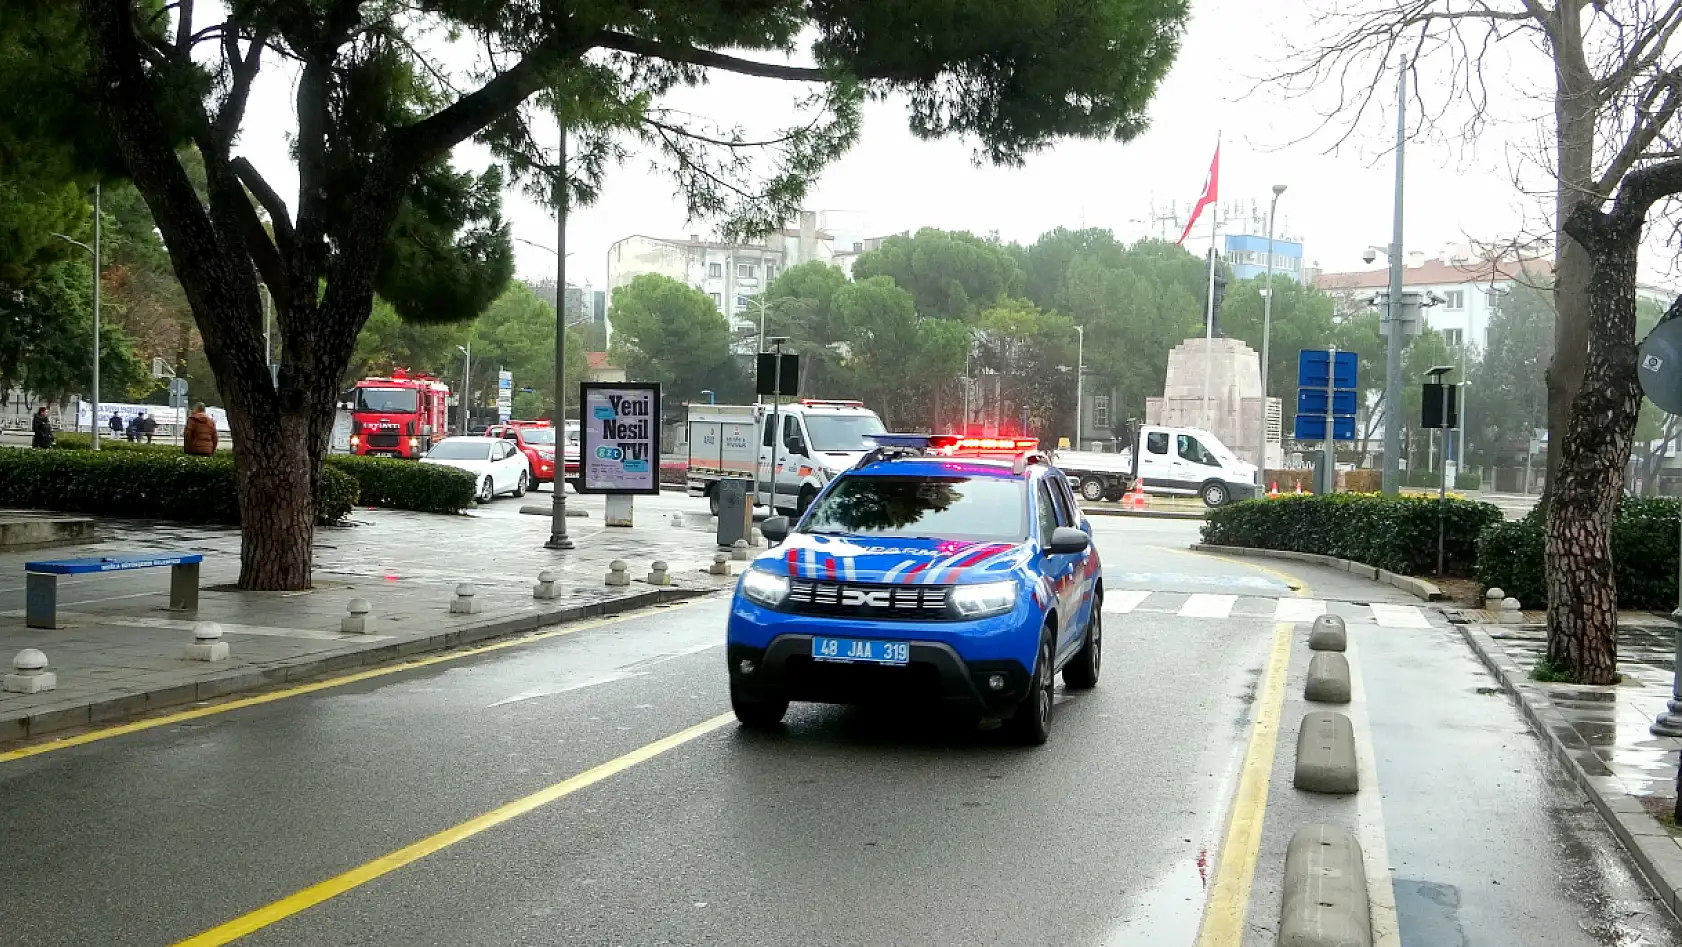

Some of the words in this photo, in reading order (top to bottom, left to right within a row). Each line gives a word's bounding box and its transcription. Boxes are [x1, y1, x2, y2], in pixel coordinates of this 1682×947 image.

[609, 395, 648, 416] Yeni
[603, 419, 648, 439] Nesil
[821, 640, 838, 655] 48
[848, 642, 872, 658] JAA
[884, 644, 907, 661] 319
